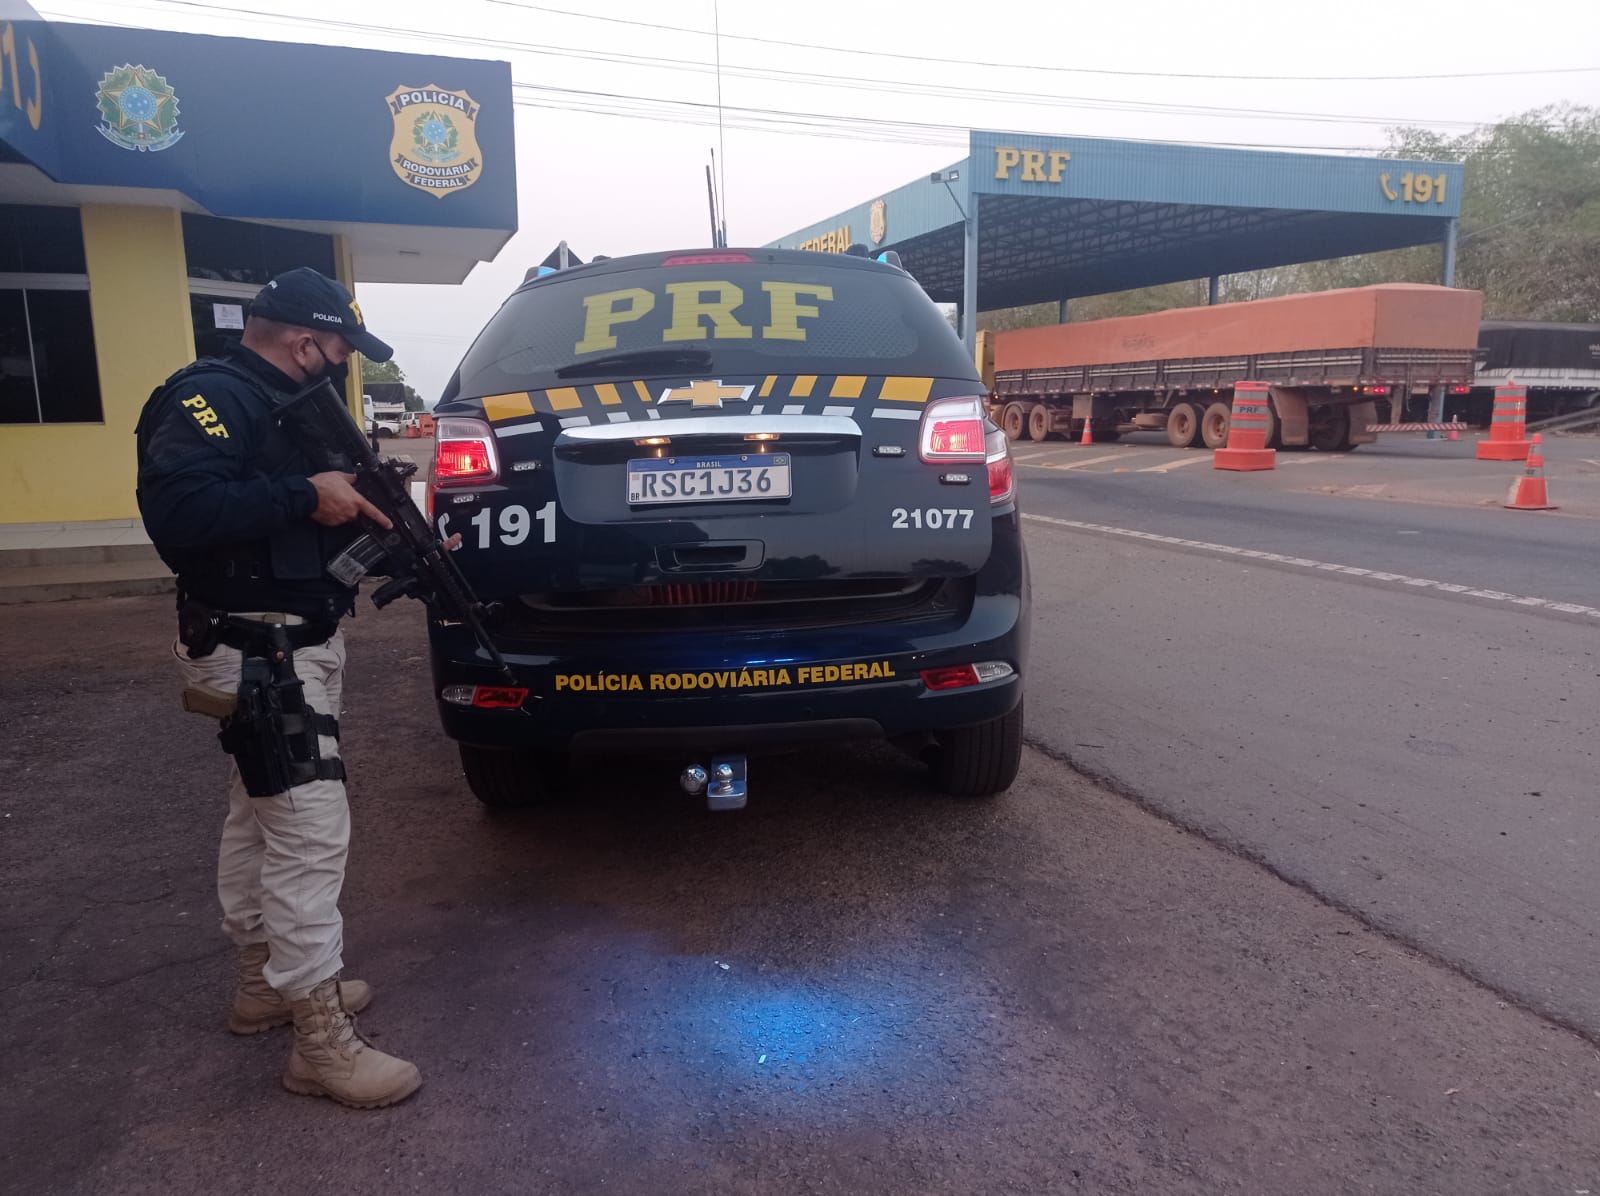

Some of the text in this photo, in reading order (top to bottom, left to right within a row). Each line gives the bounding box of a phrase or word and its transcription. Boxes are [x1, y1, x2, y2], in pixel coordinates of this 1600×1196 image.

[994, 146, 1071, 182] PRF
[414, 176, 463, 188] FEDERAL
[1401, 172, 1446, 203] 191
[313, 312, 343, 324] POLICIA
[575, 280, 834, 355] PRF
[182, 394, 230, 439] PRF
[696, 461, 722, 469] BRASIL
[631, 492, 640, 501] BR
[641, 468, 772, 498] RSC1J36
[471, 501, 556, 549] 191
[891, 507, 974, 529] 21077
[555, 660, 896, 691] POLÍCIA RODOVIÁRIA FEDERAL
